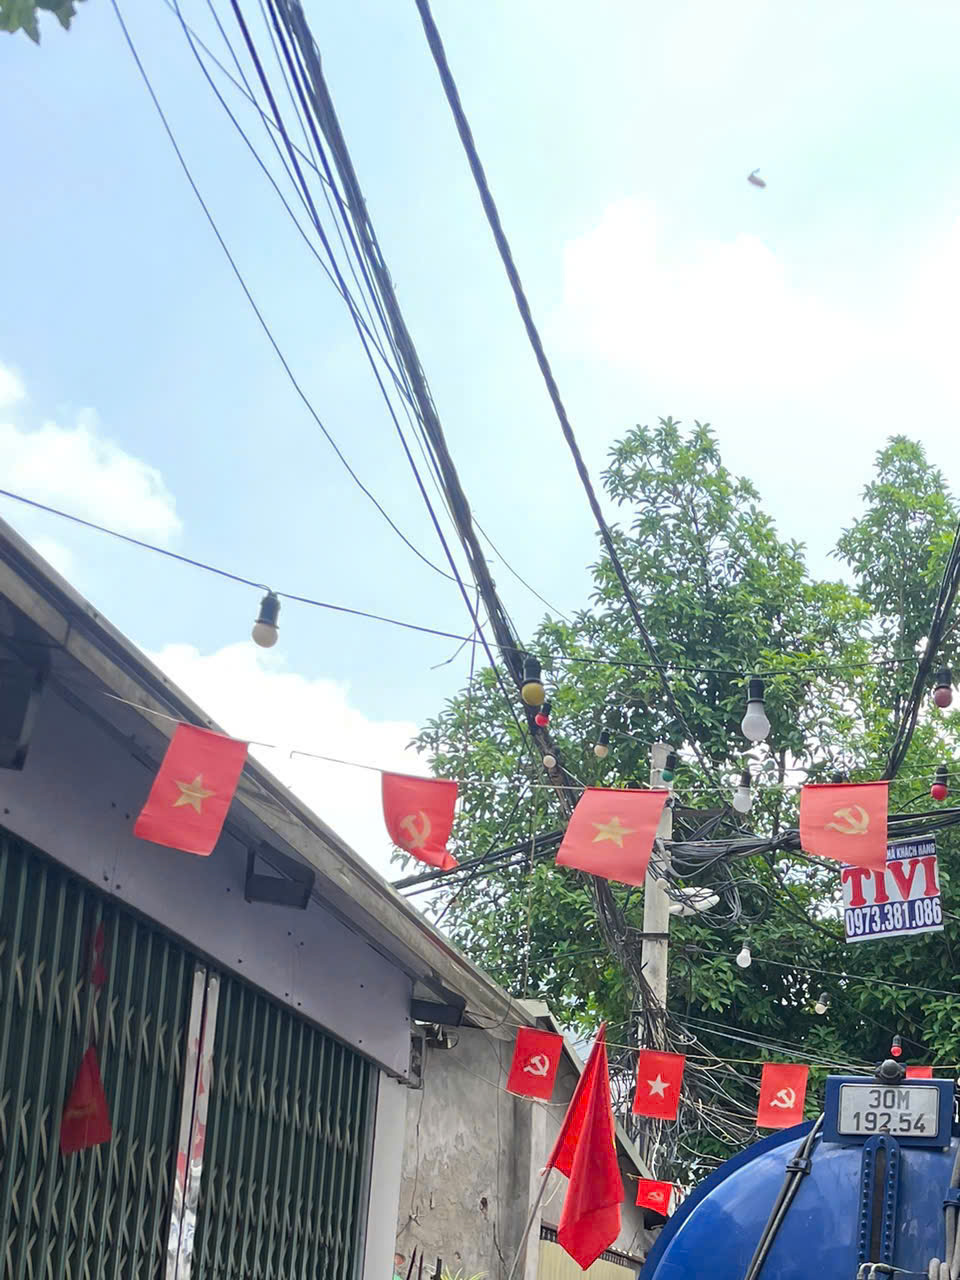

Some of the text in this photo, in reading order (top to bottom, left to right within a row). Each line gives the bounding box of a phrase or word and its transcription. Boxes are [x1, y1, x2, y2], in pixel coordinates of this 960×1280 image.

[842, 856, 940, 907] TIVI
[846, 898, 942, 936] 0973.381.086
[869, 1089, 910, 1110] 30M
[853, 1111, 926, 1133] 192.54
